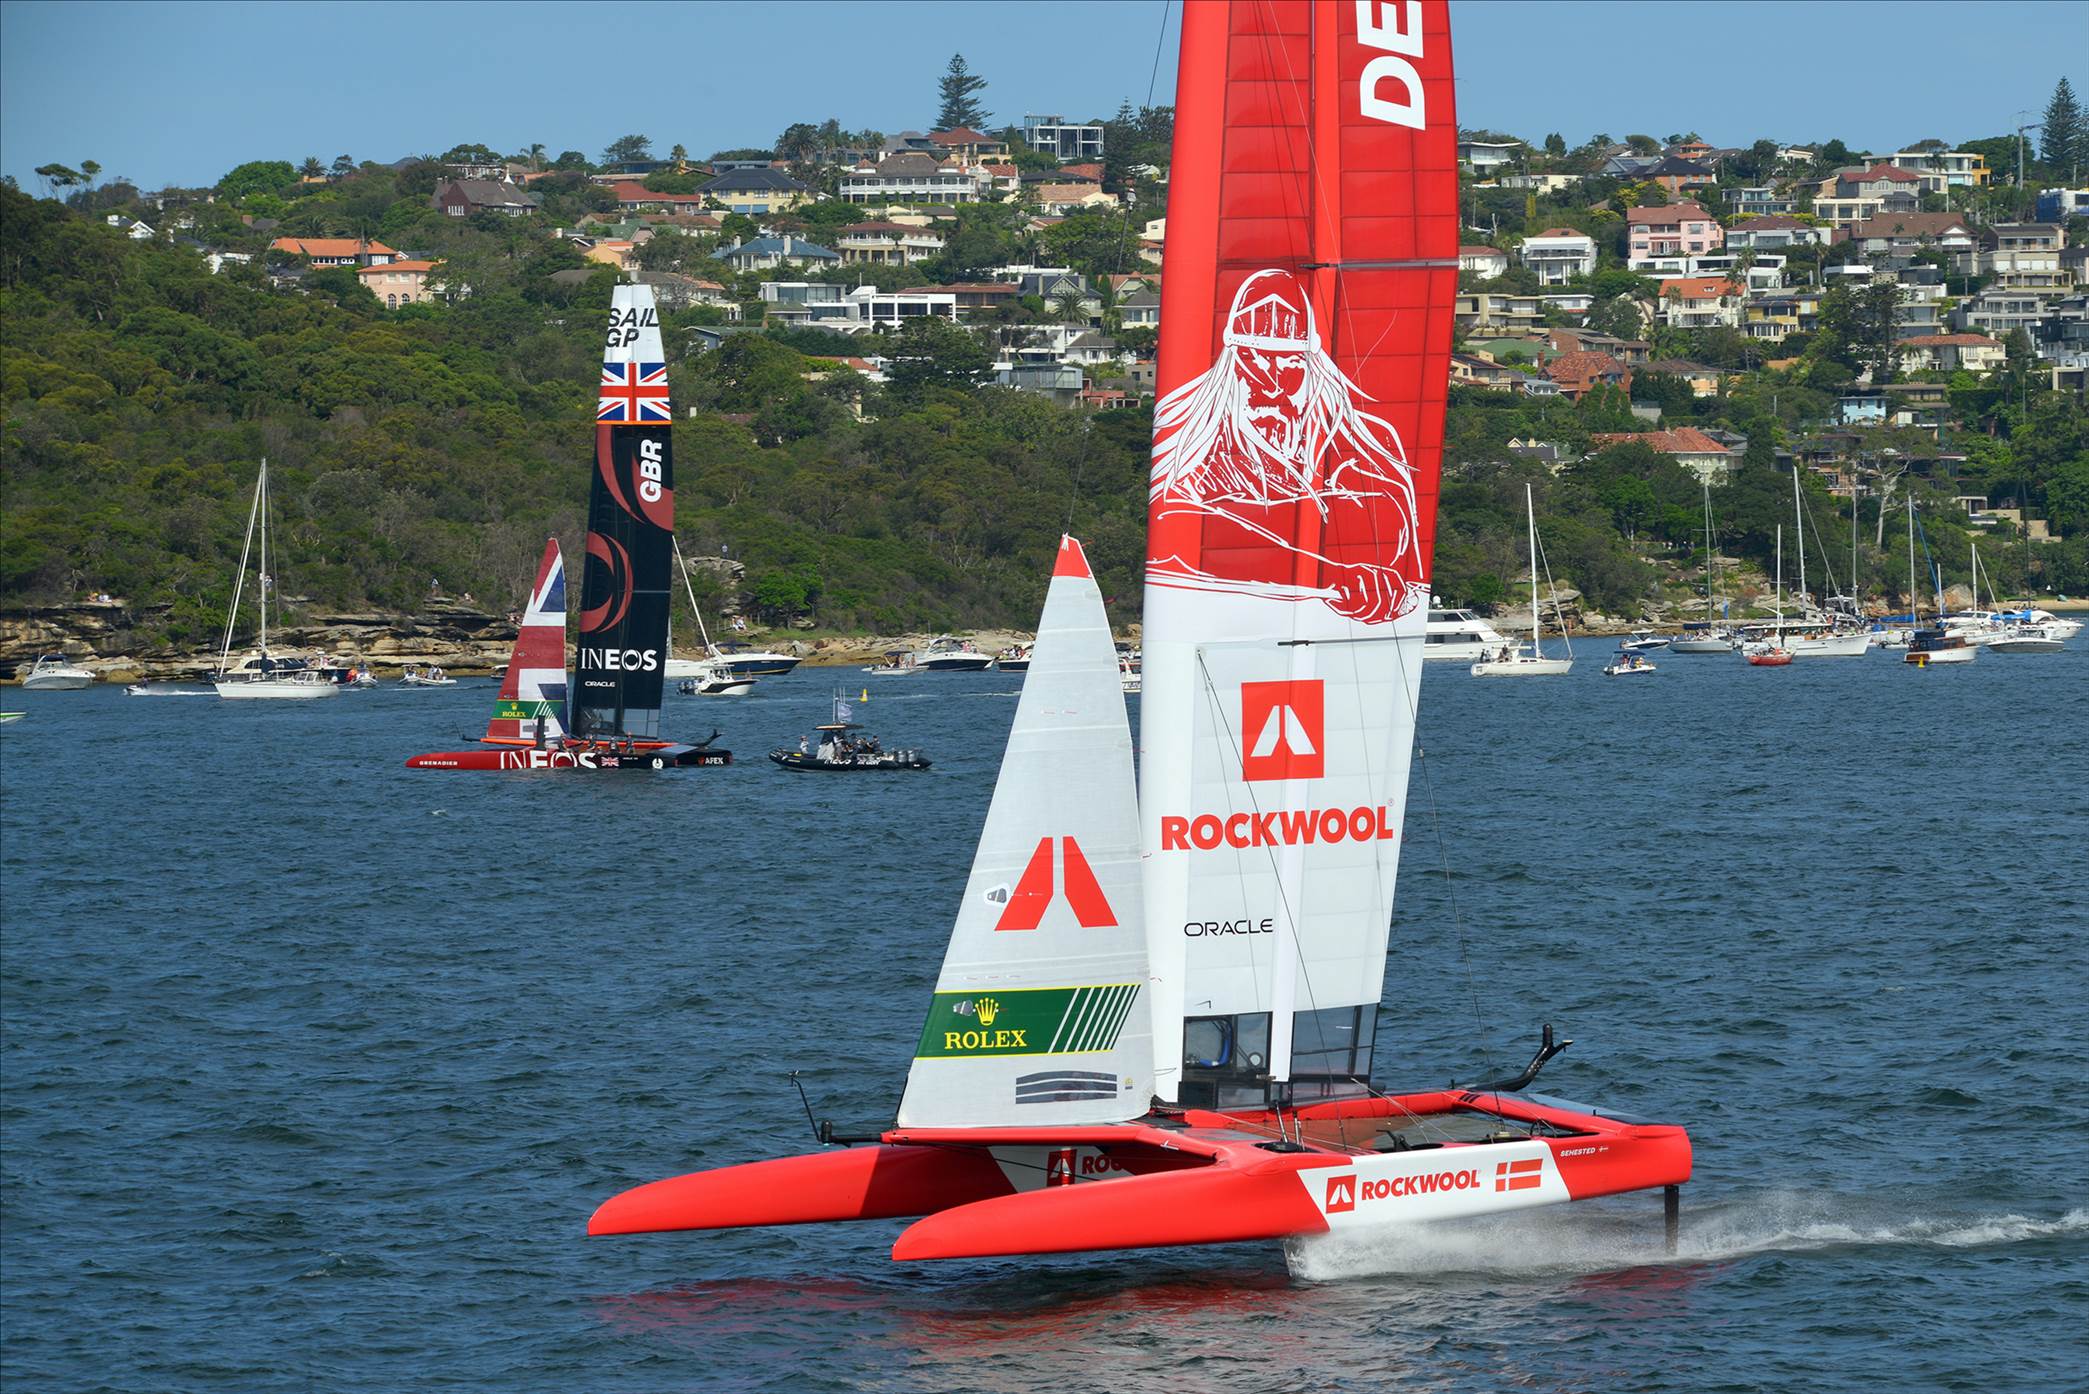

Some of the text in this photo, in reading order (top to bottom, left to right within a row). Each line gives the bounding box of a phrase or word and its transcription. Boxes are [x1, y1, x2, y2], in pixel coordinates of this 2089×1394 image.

[608, 308, 659, 327] SAIL
[606, 328, 639, 347] GP
[640, 439, 662, 503] GBR
[581, 648, 657, 671] INEOS
[500, 751, 598, 769] INEOS
[705, 757, 723, 765] AFEX
[1161, 806, 1393, 850] ROCKWOOL
[1184, 918, 1273, 937] ORACLE
[944, 1029, 1027, 1050] ROLEX
[1560, 1147, 1596, 1157] SEHESTED
[1361, 1169, 1480, 1201] ROCKWOOL
